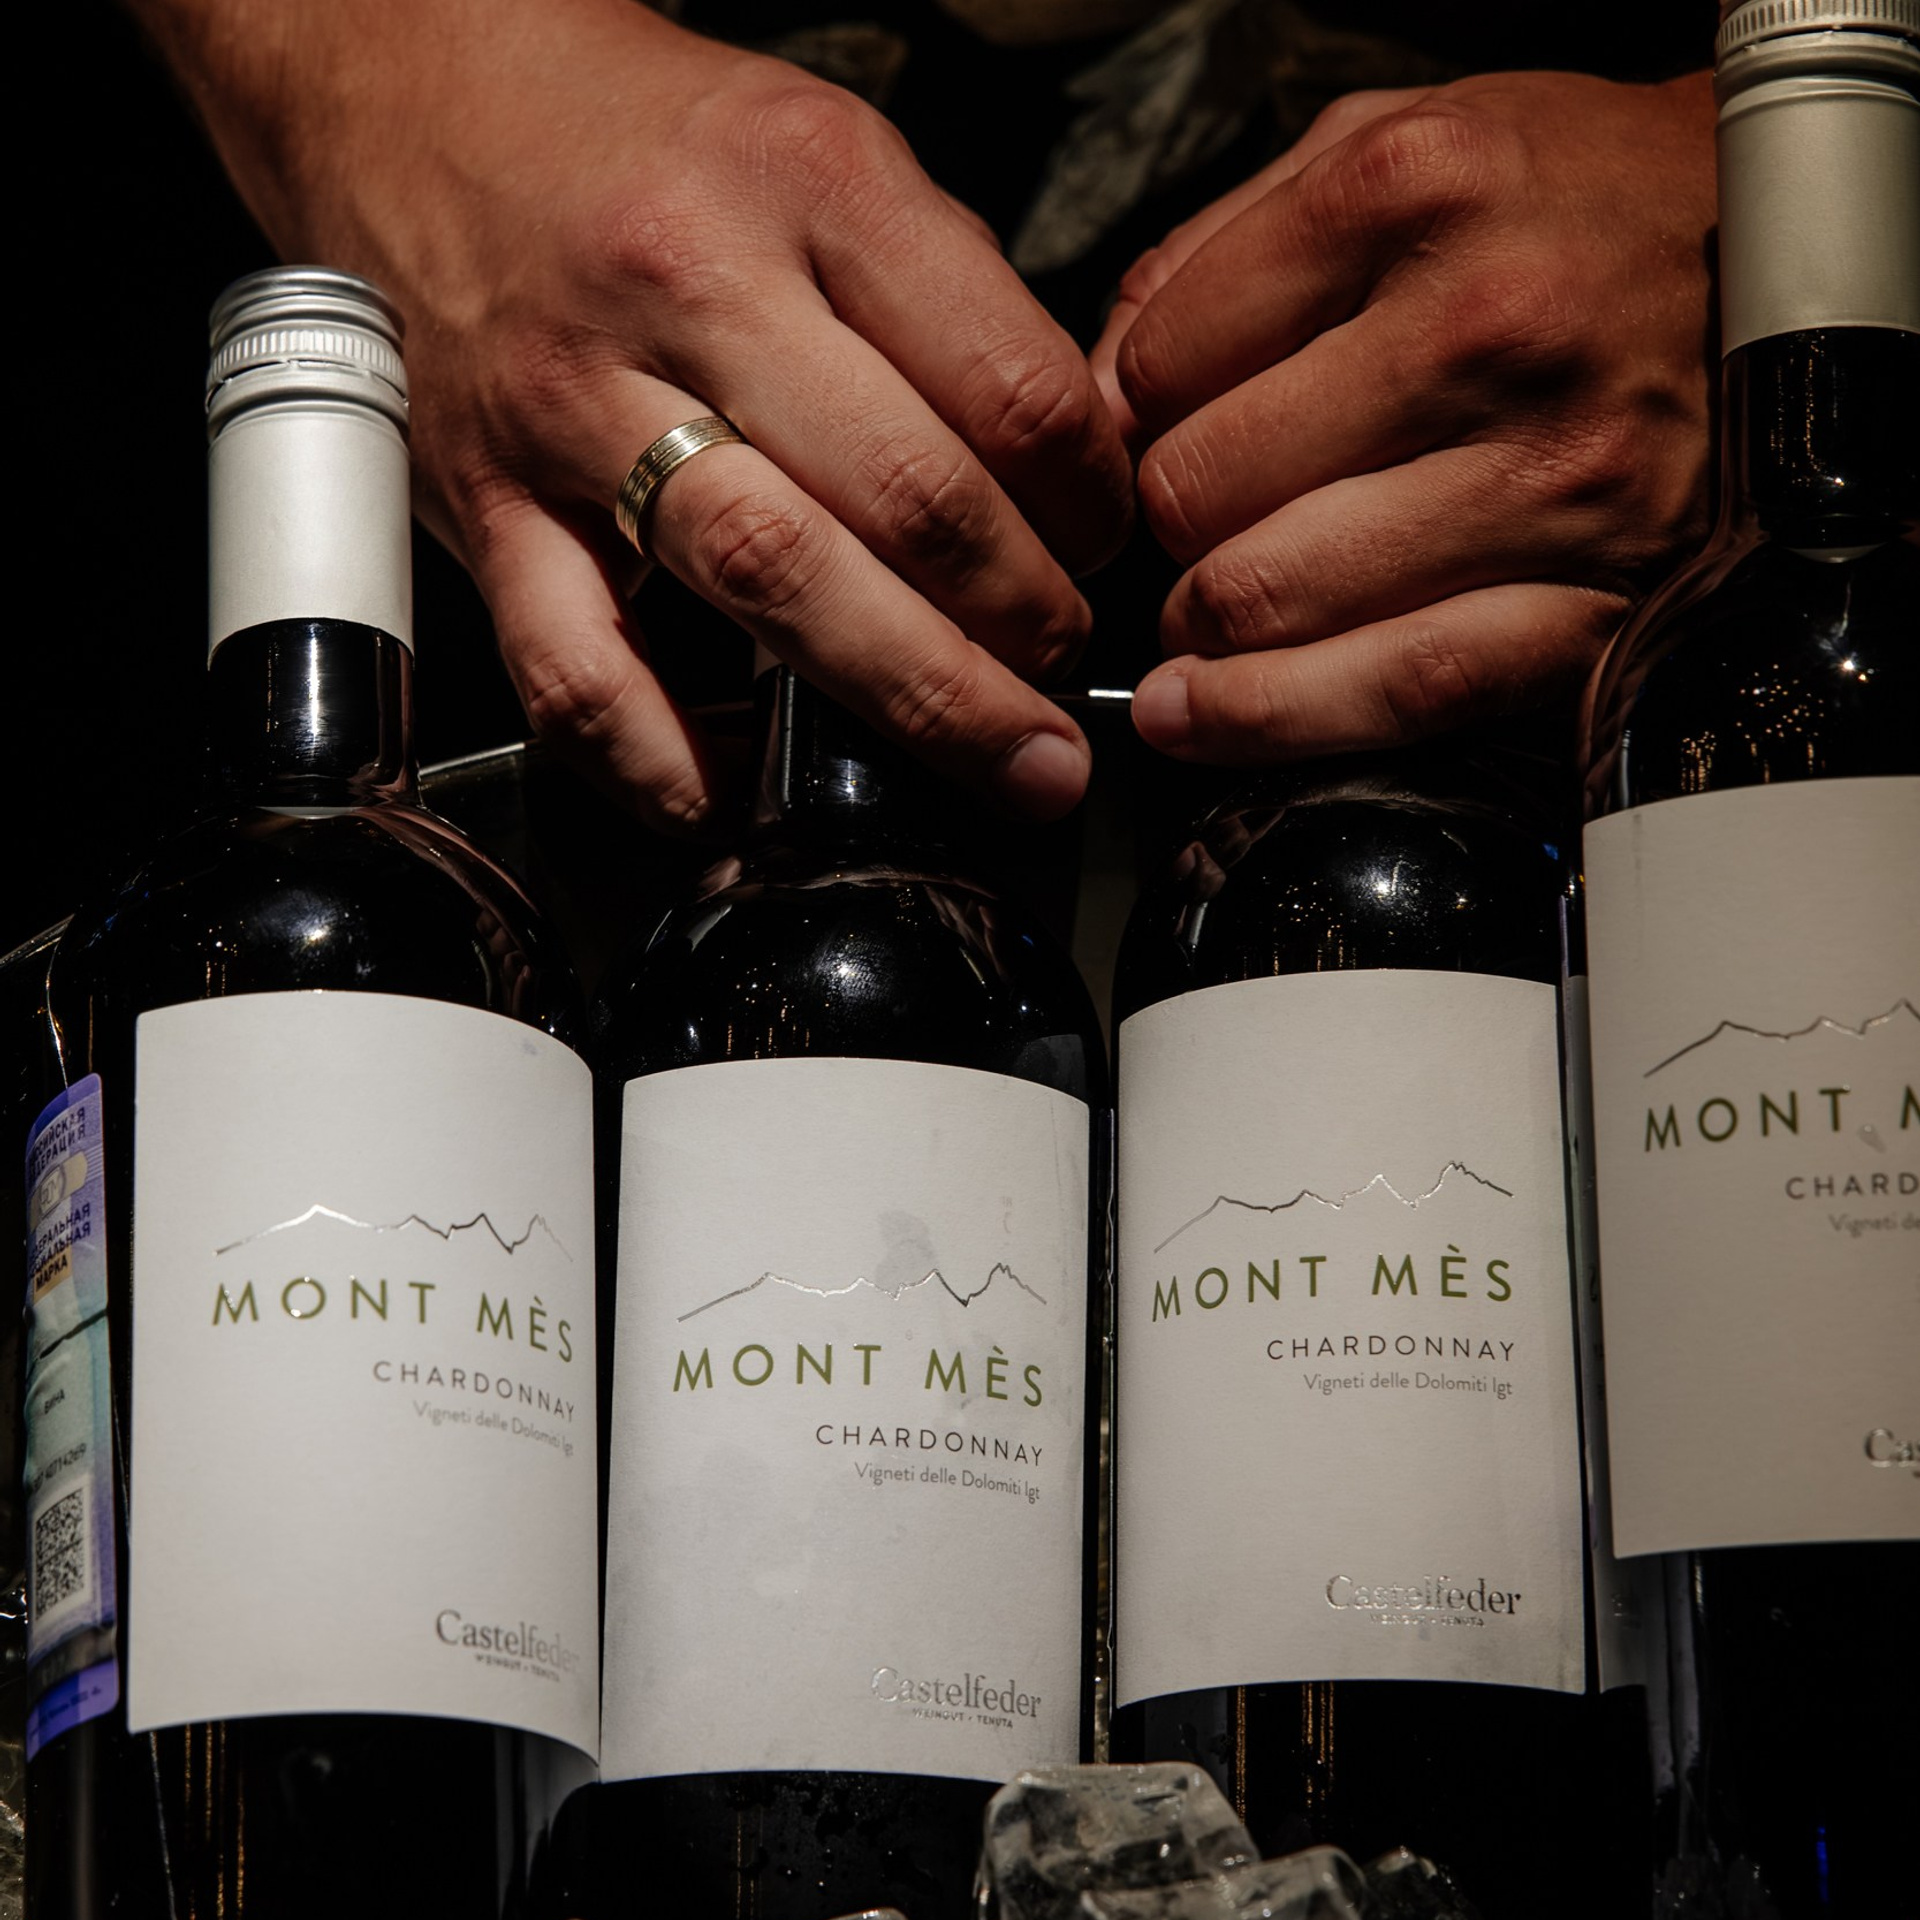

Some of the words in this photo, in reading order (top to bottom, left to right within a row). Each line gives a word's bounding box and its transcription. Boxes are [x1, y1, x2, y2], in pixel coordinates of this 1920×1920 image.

[31, 1106, 86, 1164] ССИЙСКАЯ
[1645, 1087, 1852, 1153] MONT
[31, 1124, 87, 1181] ДЕРАЦИЯ
[1785, 1172, 1920, 1200] CHARD
[31, 1203, 90, 1260] ЕРАЛЬНАЯ
[31, 1222, 91, 1277] ЦИАЛЬНАЯ
[36, 1254, 68, 1291] МАРКА
[1152, 1255, 1327, 1322] MONT
[1372, 1244, 1512, 1302] MÈS
[212, 1277, 436, 1326] MONT
[476, 1292, 573, 1363] MÈS
[1267, 1335, 1514, 1362] CHARDONNAY
[373, 1360, 575, 1423] CHARDONNAY
[673, 1343, 882, 1392] MONT
[924, 1345, 1043, 1407] MÈS
[1303, 1372, 1365, 1395] Vigneti
[1369, 1372, 1410, 1389] delle
[1415, 1372, 1487, 1392] Dolomiti
[412, 1400, 472, 1427] Vigneti
[475, 1410, 508, 1432] delle
[816, 1424, 1043, 1466] CHARDONNAY
[1864, 1428, 1920, 1468] Ca
[854, 1462, 915, 1487] Vigneti
[920, 1467, 957, 1485] delle
[961, 1469, 1021, 1496] Dolomiti
[1325, 1574, 1521, 1615] Castelfeder
[871, 1666, 1042, 1718] Castelfeder
[976, 1714, 1014, 1730] TENUTA
